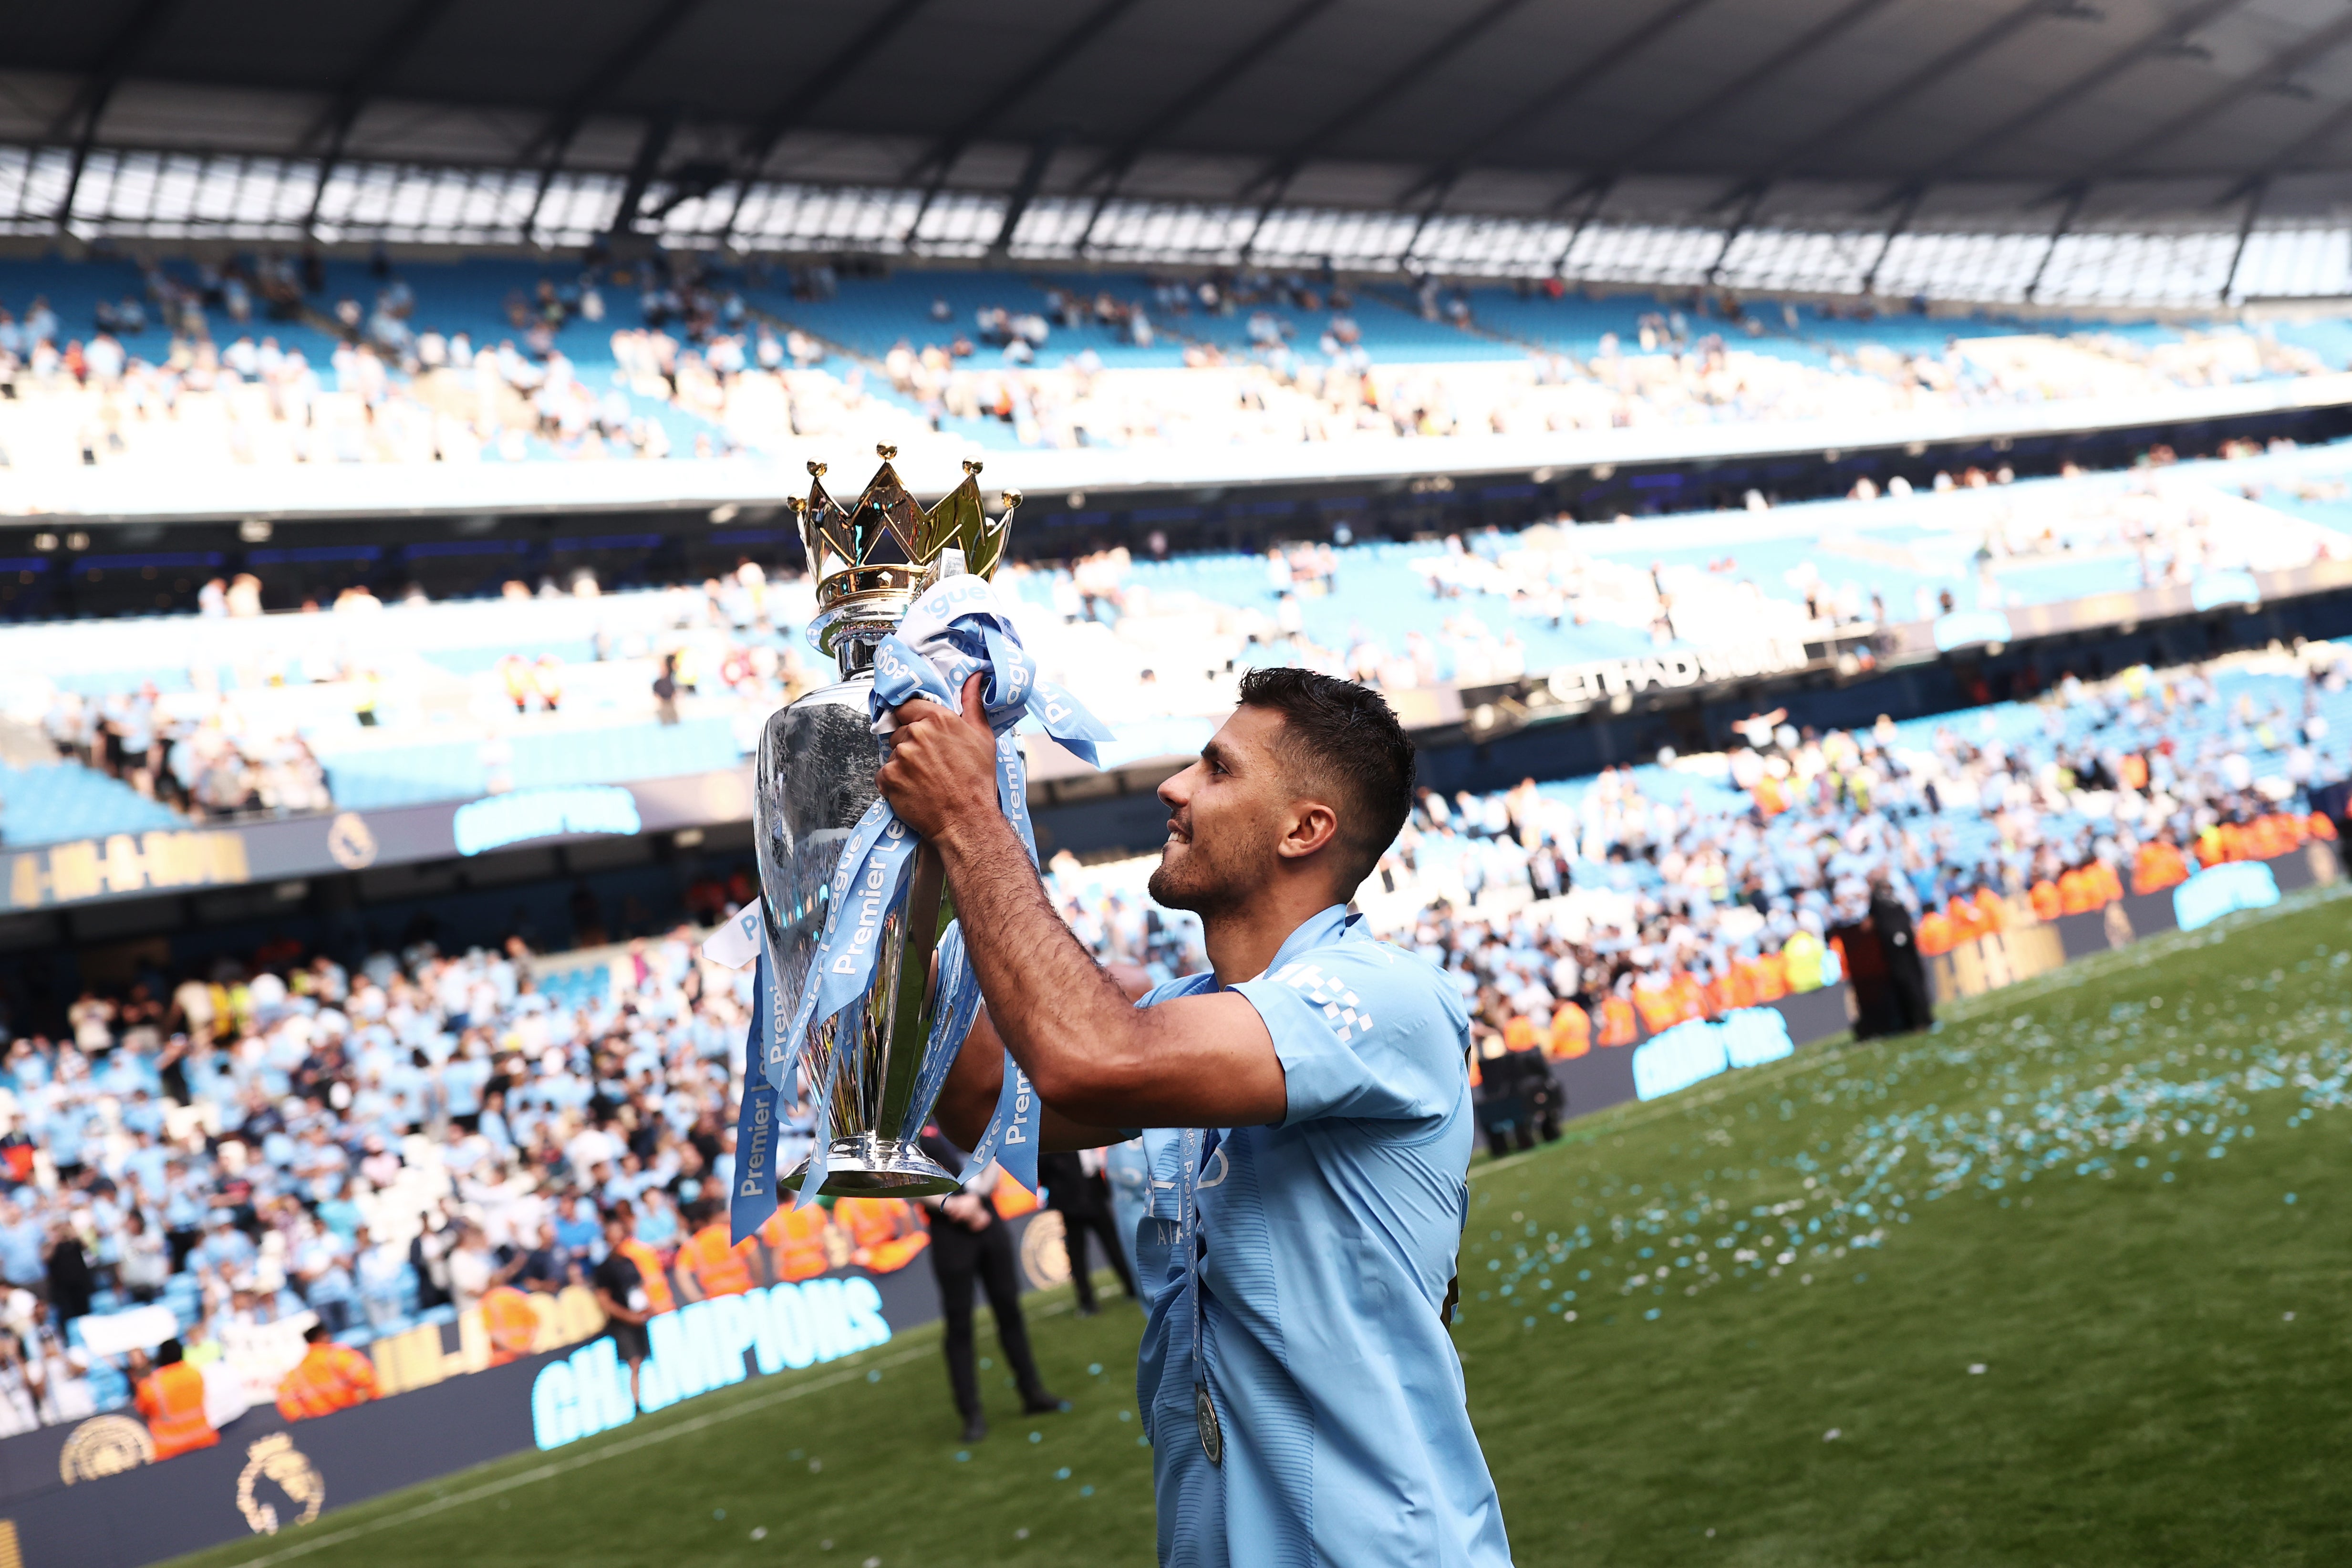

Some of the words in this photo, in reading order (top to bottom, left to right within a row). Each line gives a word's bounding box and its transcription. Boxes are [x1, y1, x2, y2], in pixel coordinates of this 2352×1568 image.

[923, 586, 986, 619] gue
[820, 833, 863, 953] League
[831, 856, 888, 975] Premier
[740, 1097, 770, 1197] Premier
[973, 1112, 1002, 1164] Pre
[1183, 1160, 1194, 1239] Premier
